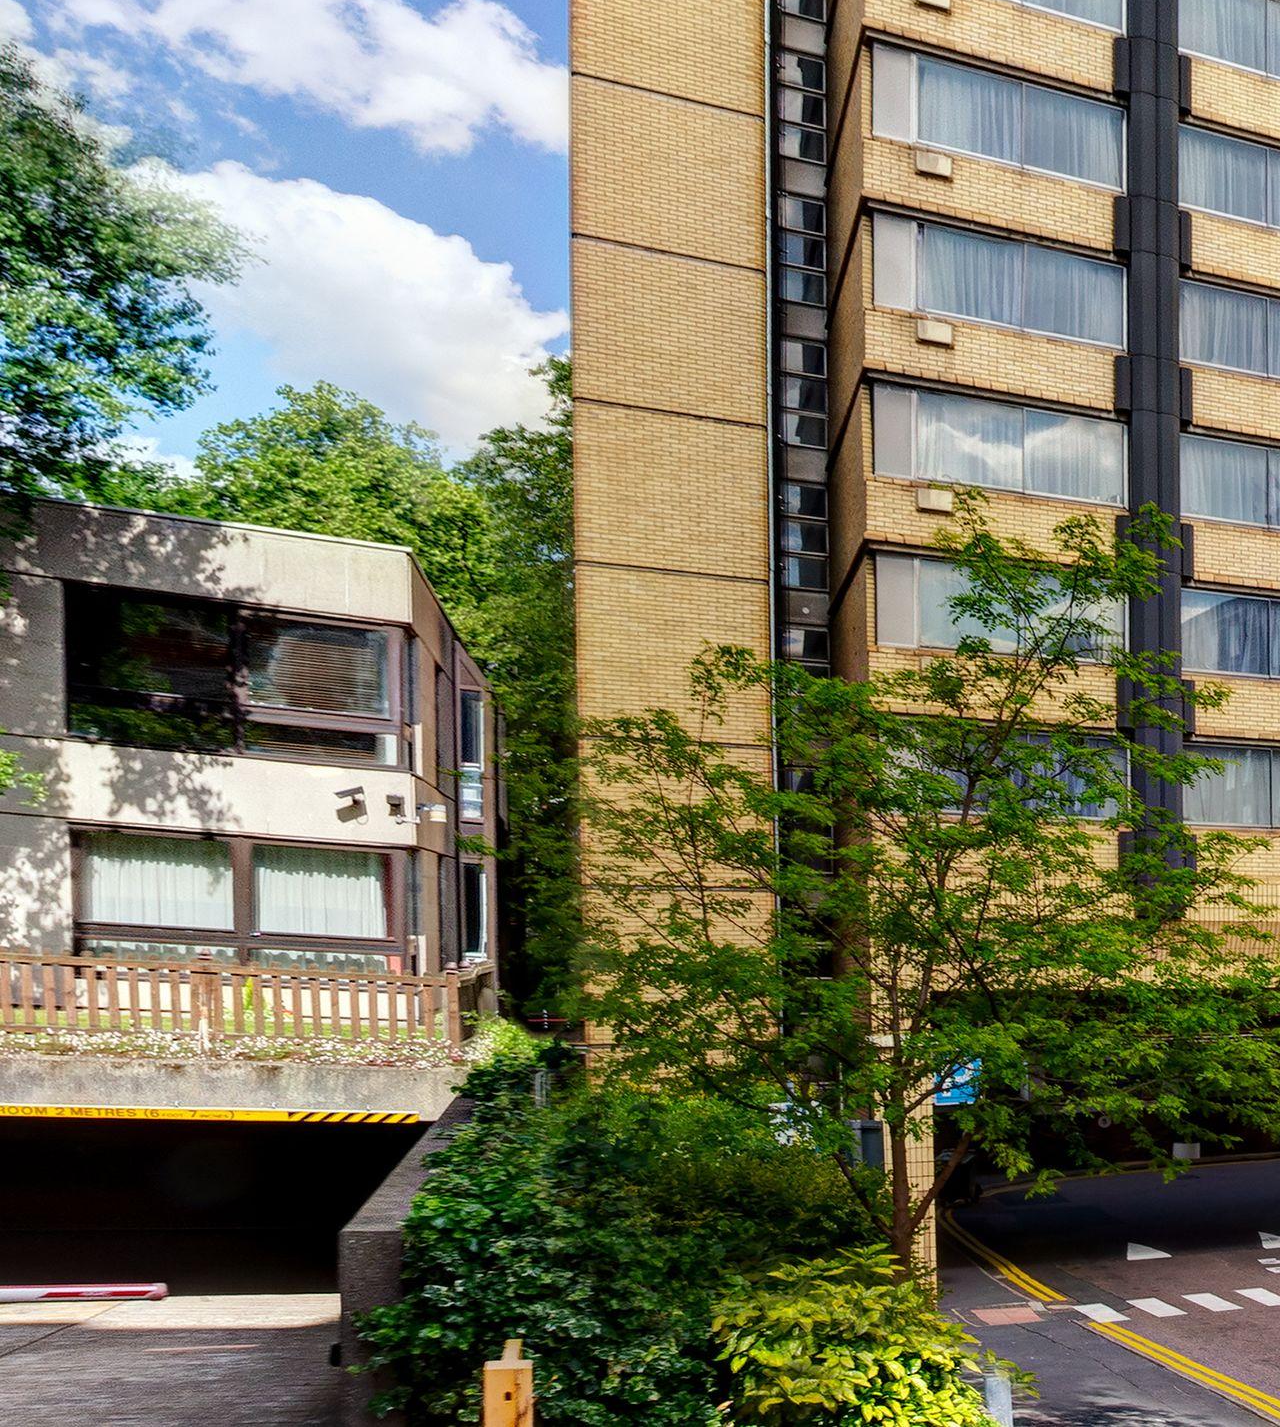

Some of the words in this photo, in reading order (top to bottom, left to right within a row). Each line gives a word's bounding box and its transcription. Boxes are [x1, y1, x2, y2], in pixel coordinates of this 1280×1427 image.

[56, 1107, 65, 1116] 2
[70, 1107, 137, 1118] METRES
[189, 1109, 198, 1118] 7
